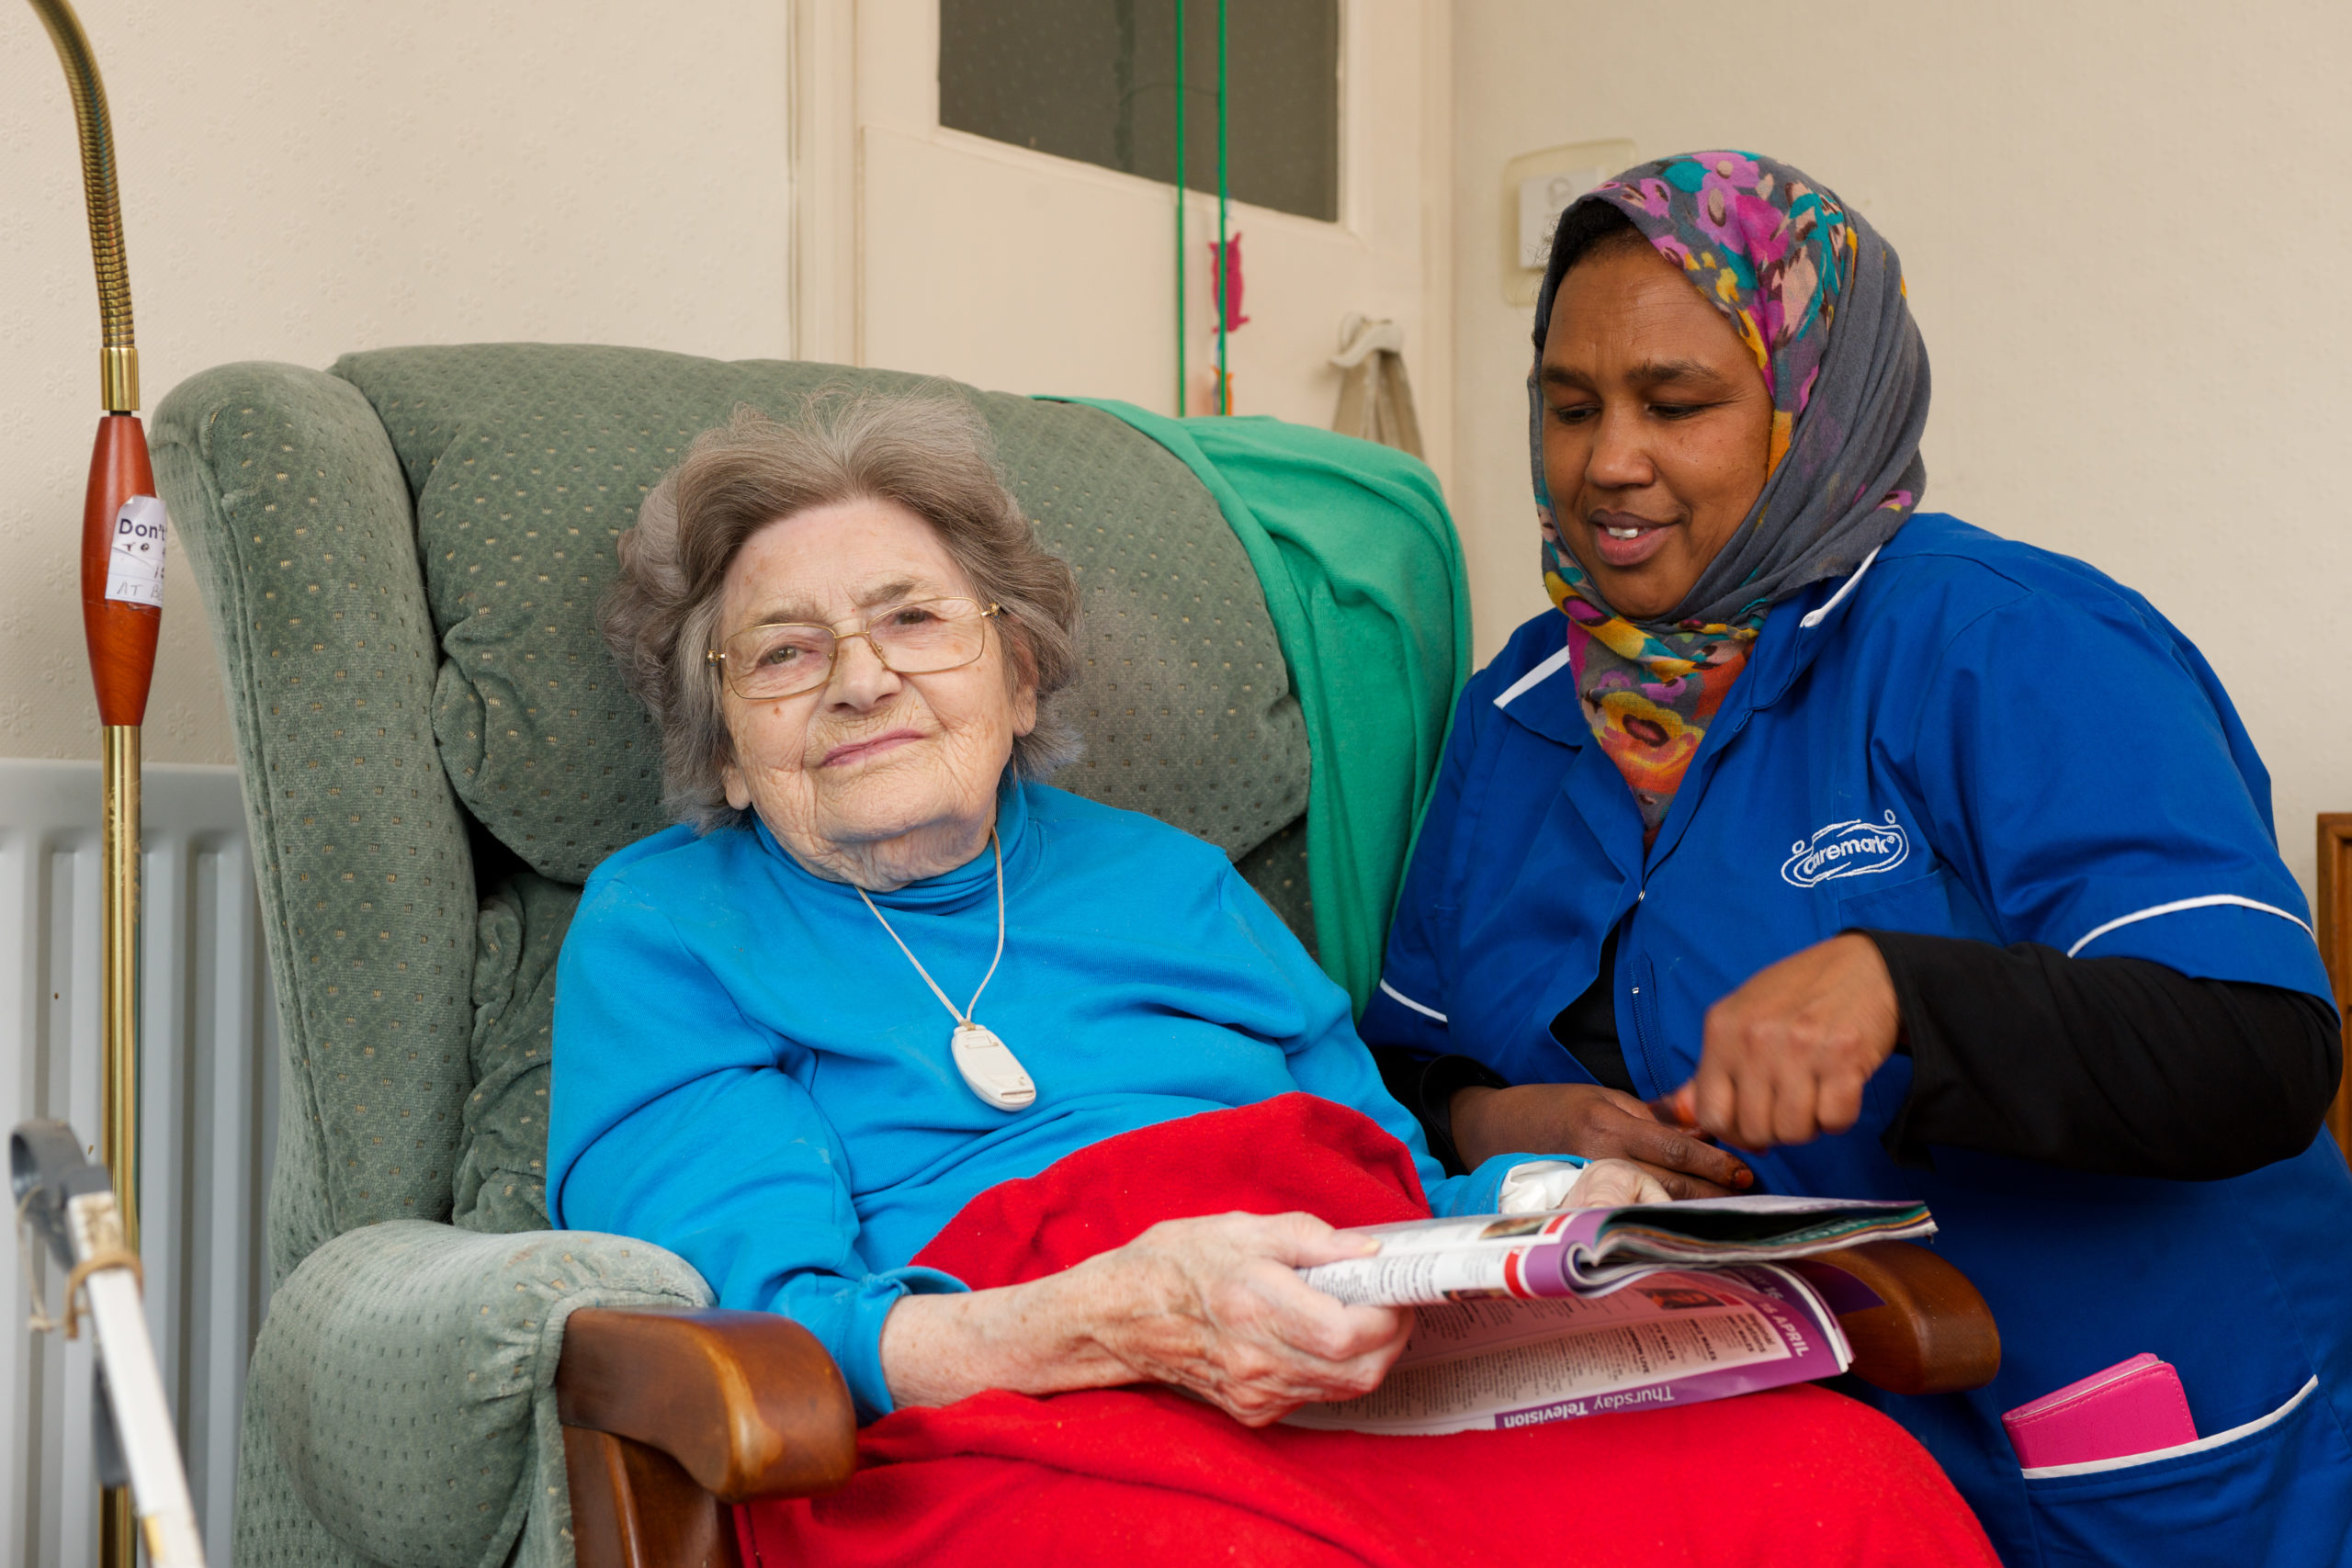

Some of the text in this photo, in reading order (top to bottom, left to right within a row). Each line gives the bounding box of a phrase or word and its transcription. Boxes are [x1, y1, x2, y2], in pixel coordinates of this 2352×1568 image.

[119, 518, 165, 541] Don't
[117, 581, 142, 596] AT
[1659, 1335, 1676, 1360] WALES
[1772, 1313, 1810, 1358] APRIL
[1702, 1336, 1717, 1361] WALES
[1640, 1354, 1651, 1374] LIVE
[1503, 1385, 1675, 1428] Thursday Television
